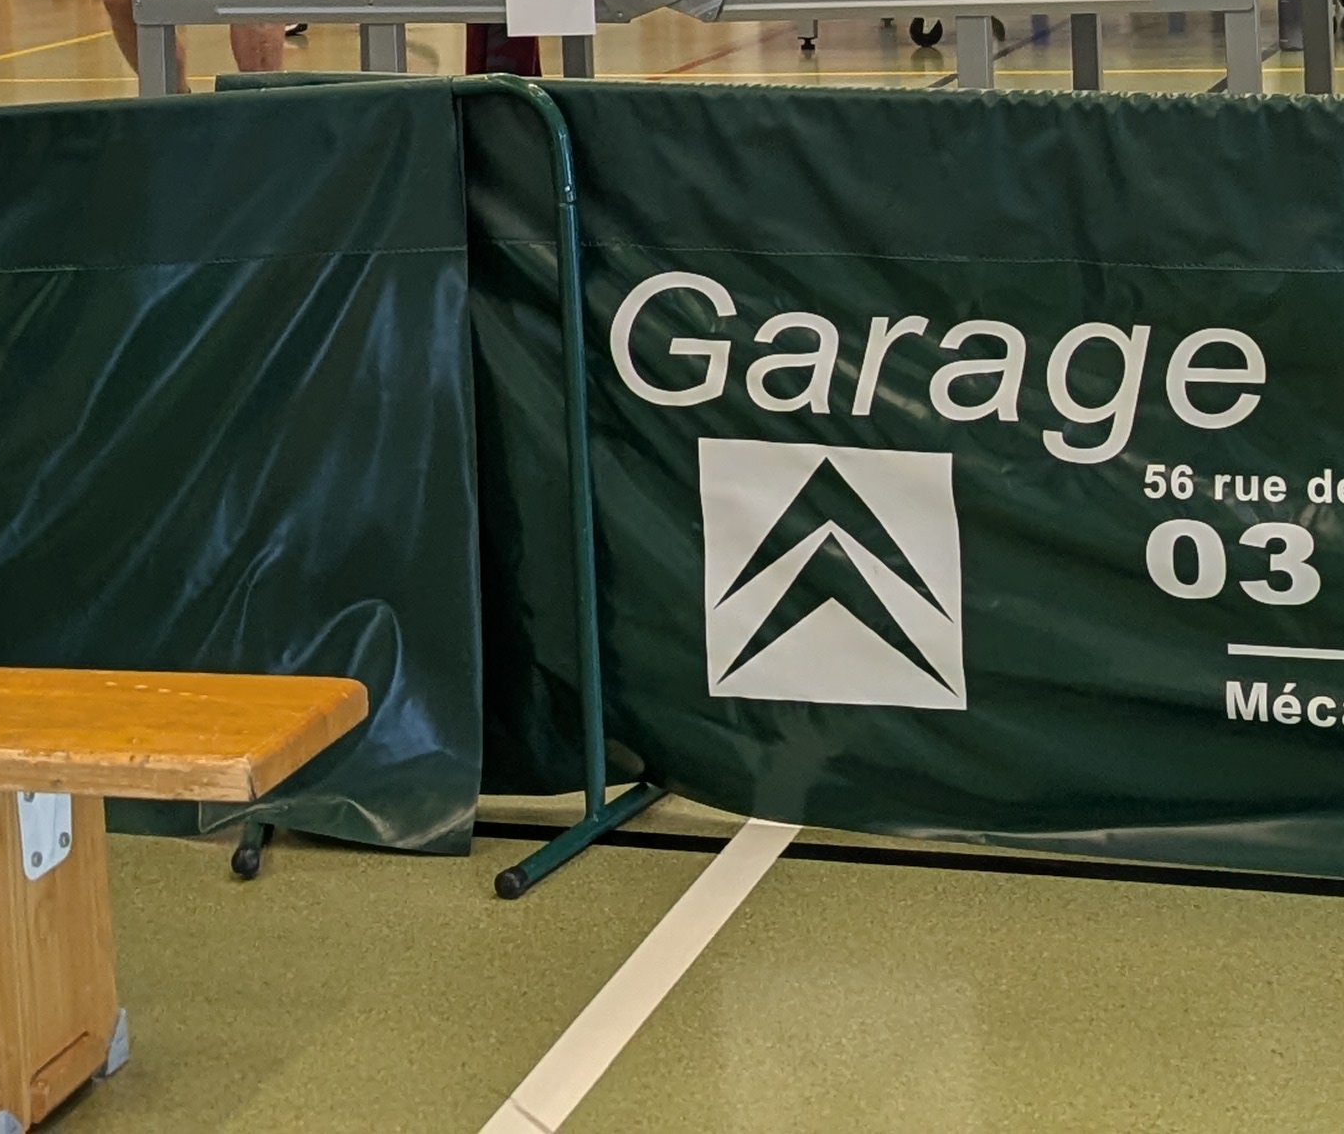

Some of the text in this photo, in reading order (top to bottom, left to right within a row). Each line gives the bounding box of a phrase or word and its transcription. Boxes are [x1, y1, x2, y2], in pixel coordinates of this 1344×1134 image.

[611, 272, 1265, 464] Garage
[1144, 465, 1194, 500] 56
[1215, 475, 1287, 503] rue
[1146, 519, 1321, 606] 03
